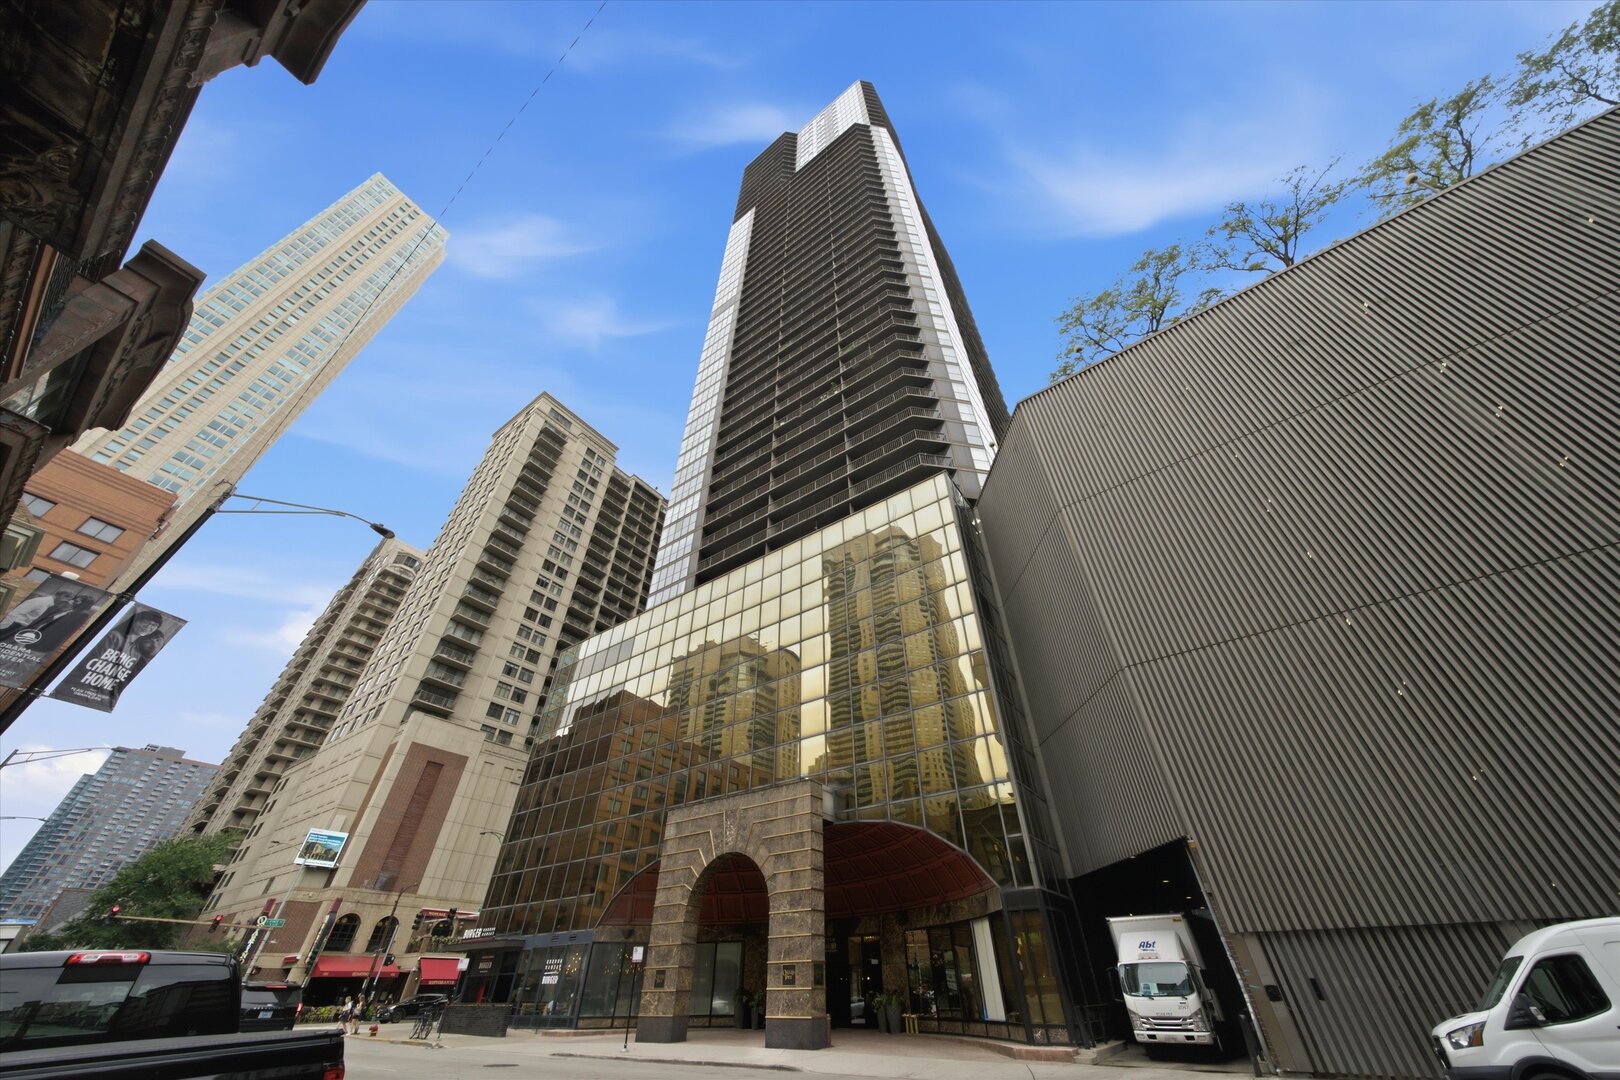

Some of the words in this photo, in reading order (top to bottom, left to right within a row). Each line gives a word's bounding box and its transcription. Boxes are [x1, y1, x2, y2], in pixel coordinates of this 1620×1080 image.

[0, 642, 32, 654] OBAMA
[101, 648, 137, 669] BRING
[86, 658, 132, 682] CHANGE
[81, 671, 120, 691] HOME
[1138, 940, 1156, 949] Abt
[541, 975, 559, 985] BURGER
